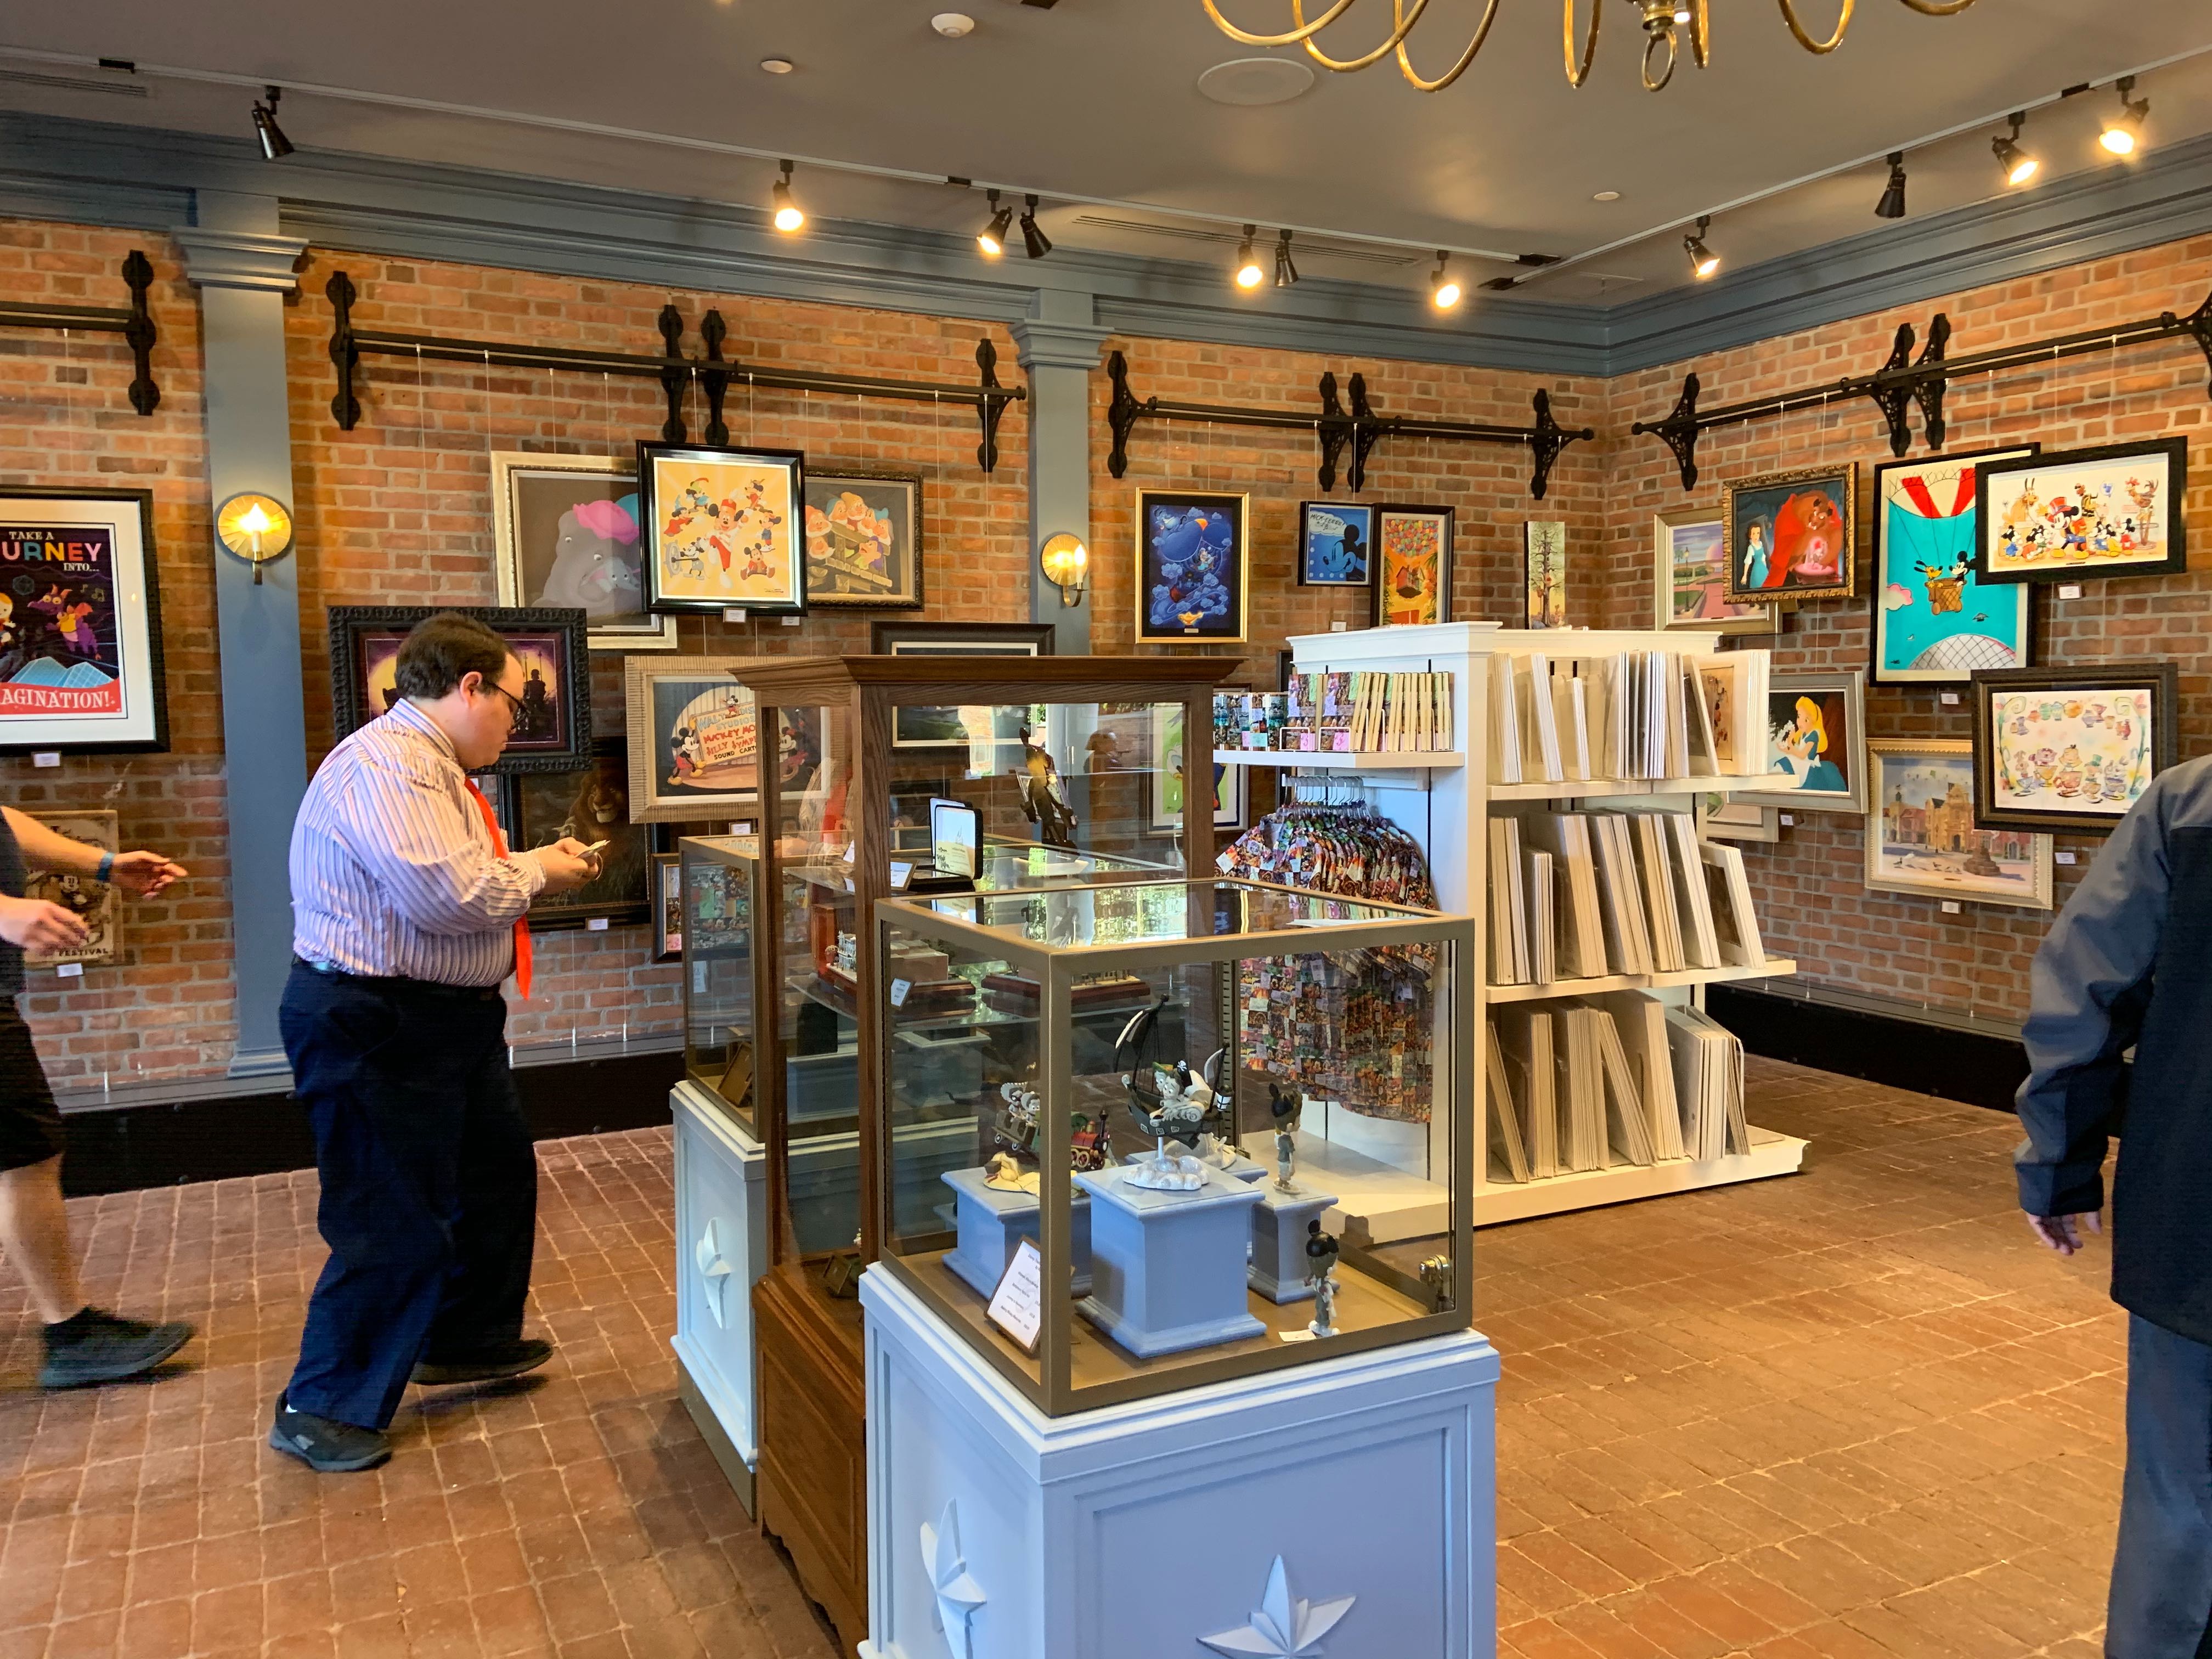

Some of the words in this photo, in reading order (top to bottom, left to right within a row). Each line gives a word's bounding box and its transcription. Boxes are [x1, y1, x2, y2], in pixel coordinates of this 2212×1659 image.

[9, 531, 42, 540] TAKE
[46, 532, 54, 540] A
[2, 541, 101, 562] URNEY
[63, 562, 100, 572] INTO...
[0, 688, 110, 709] AGINATION!
[696, 713, 725, 732] WALT
[740, 706, 755, 715] DIS
[716, 715, 755, 731] STUDIOS
[703, 728, 740, 744] MICKEY
[706, 741, 727, 756] SILLY
[732, 736, 756, 750] SYMP
[714, 751, 735, 760] SOUND
[59, 947, 109, 957] FESTIVAL
